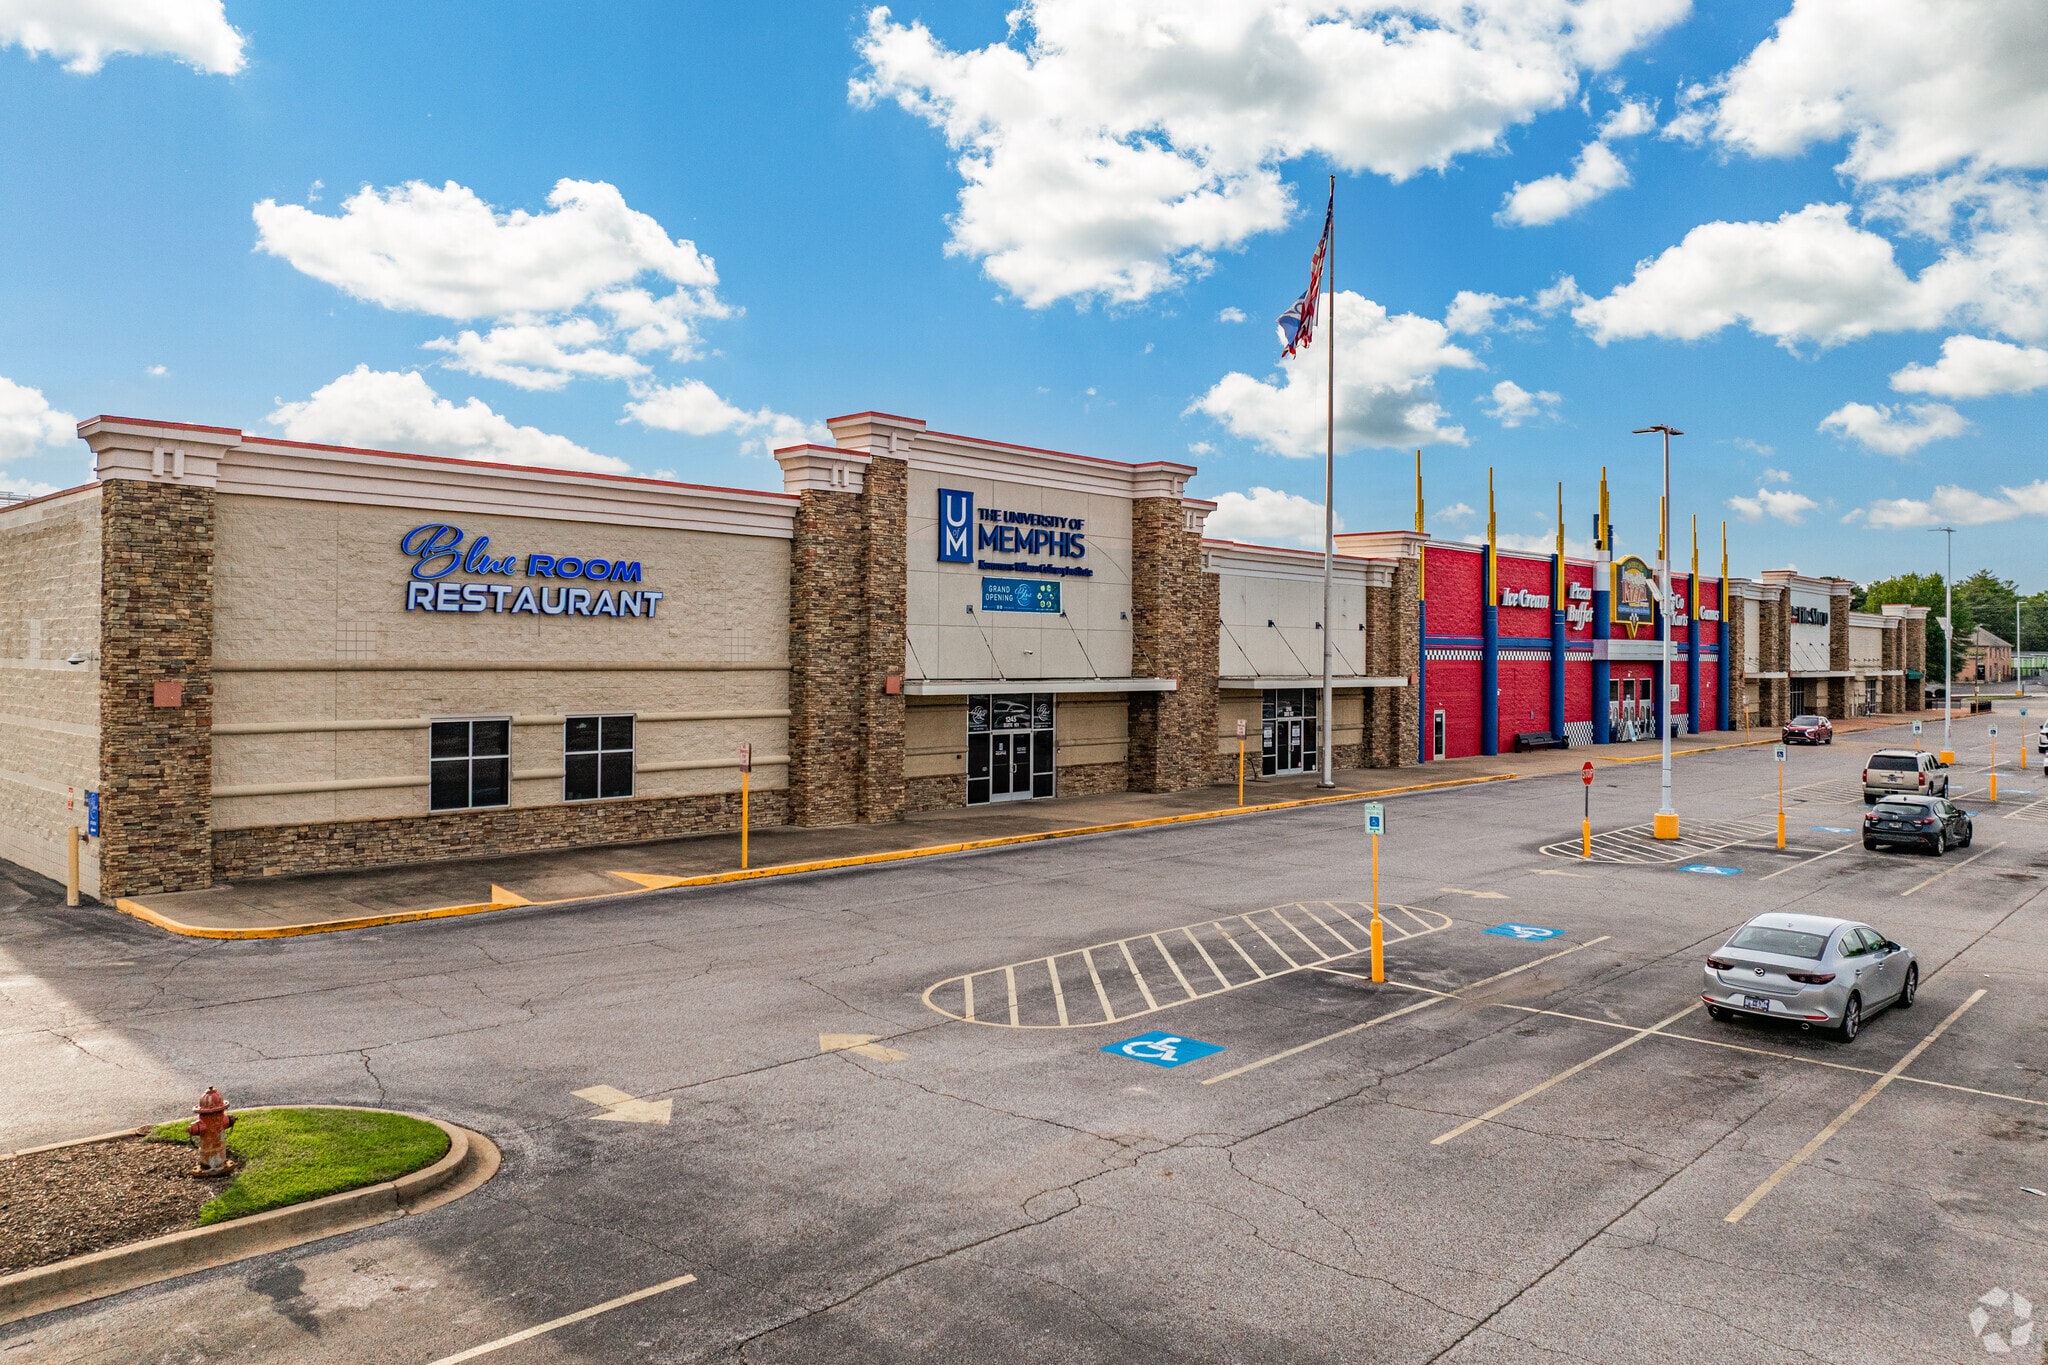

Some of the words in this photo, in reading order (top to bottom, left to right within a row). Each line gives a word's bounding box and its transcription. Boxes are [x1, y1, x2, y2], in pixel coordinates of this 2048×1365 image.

[946, 495, 967, 527] U
[978, 508, 1002, 522] THE
[1003, 510, 1068, 529] UNIVERSITY
[1068, 518, 1085, 531] OF
[401, 523, 517, 579] Blue
[527, 553, 642, 582] ROOM
[946, 525, 967, 557] M
[978, 523, 1086, 559] MEMPHIS
[406, 580, 663, 618] RESTAURANT
[985, 593, 1014, 602] OPENING
[988, 585, 1011, 593] GRAND
[1502, 587, 1518, 606] Ice
[1518, 589, 1549, 609] Cream
[1569, 581, 1592, 600] Pizza
[1567, 601, 1594, 630] Buffet
[1582, 768, 1593, 778] STOP
